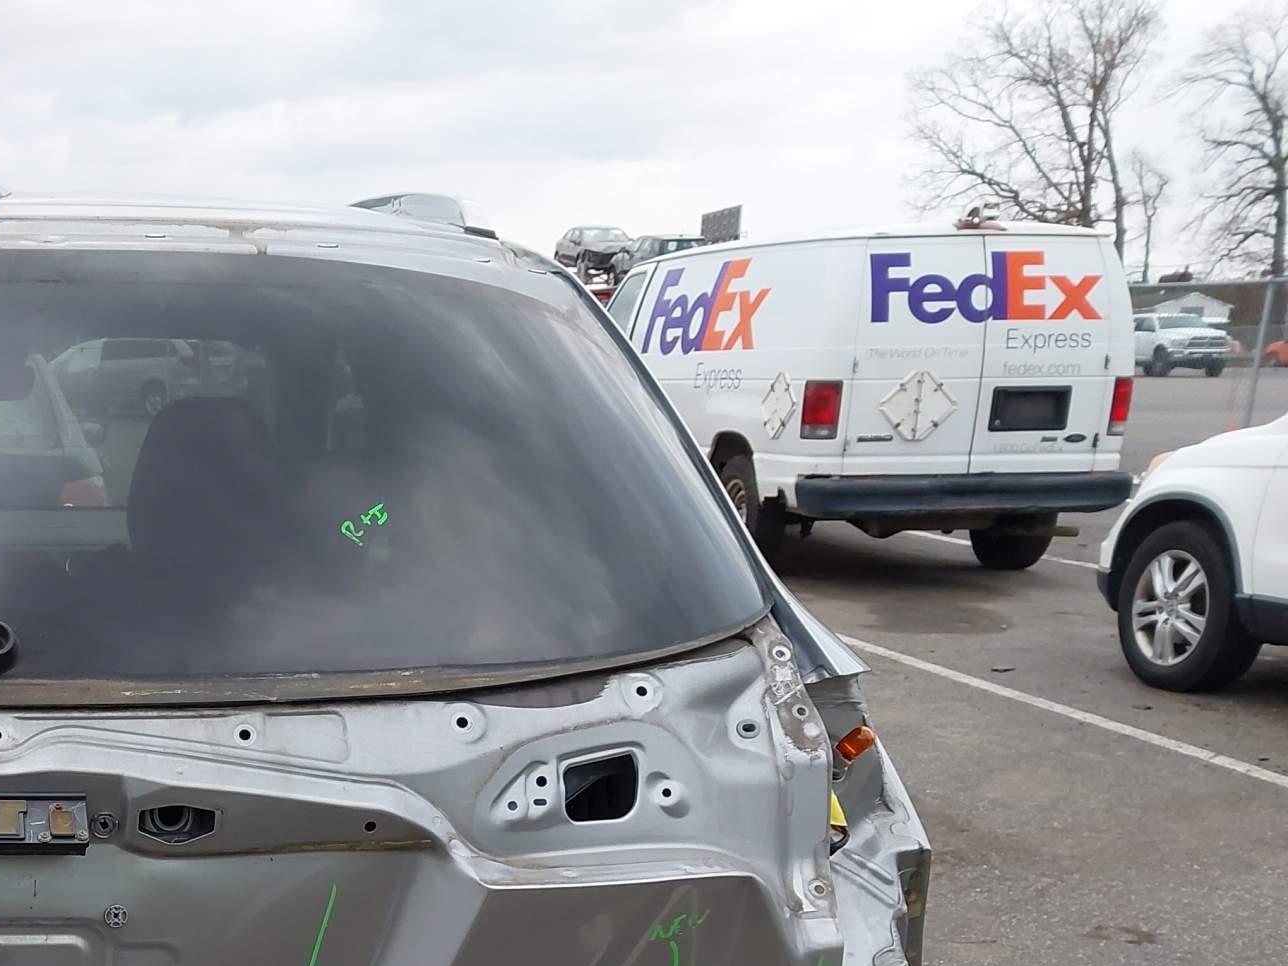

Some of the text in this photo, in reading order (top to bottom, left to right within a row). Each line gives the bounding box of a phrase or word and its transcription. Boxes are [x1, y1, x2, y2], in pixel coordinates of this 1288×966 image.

[869, 250, 1104, 324] FedEx
[641, 257, 772, 356] FedEx
[1005, 327, 1092, 353] Express
[693, 361, 743, 394] Express
[1002, 359, 1081, 376] fedex.com
